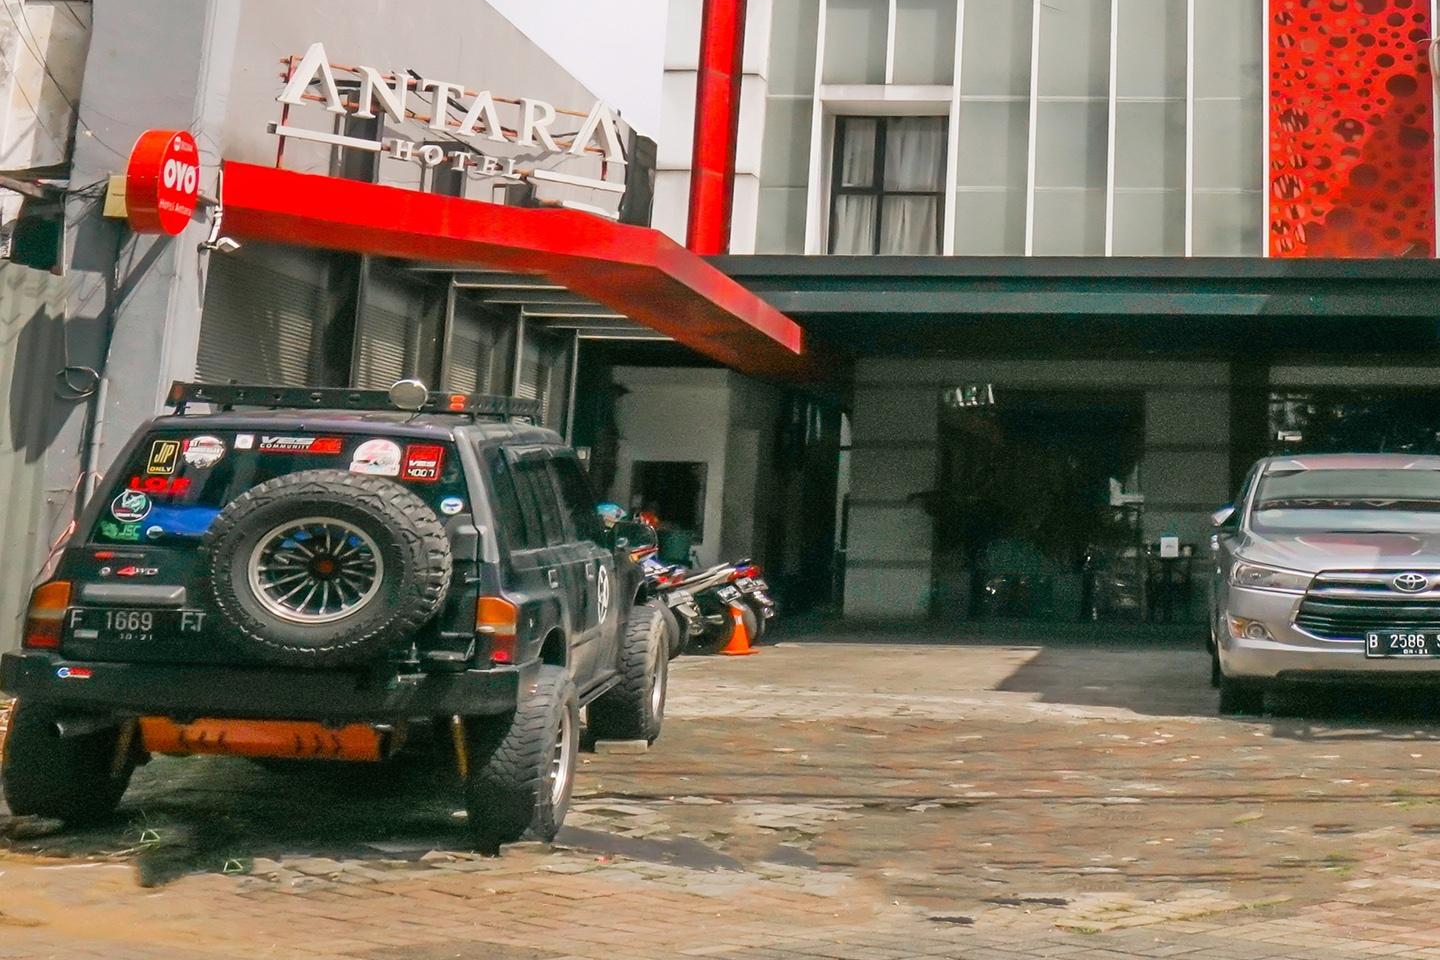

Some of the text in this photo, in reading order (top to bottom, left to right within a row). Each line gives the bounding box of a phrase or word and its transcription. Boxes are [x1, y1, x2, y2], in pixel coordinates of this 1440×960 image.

[276, 42, 628, 165] ANTARA
[163, 158, 196, 194] OYO
[390, 139, 521, 179] HOTEL
[70, 609, 83, 628] F
[105, 611, 153, 631] 1669
[1369, 634, 1378, 648] B
[1390, 634, 1425, 648] 2586
